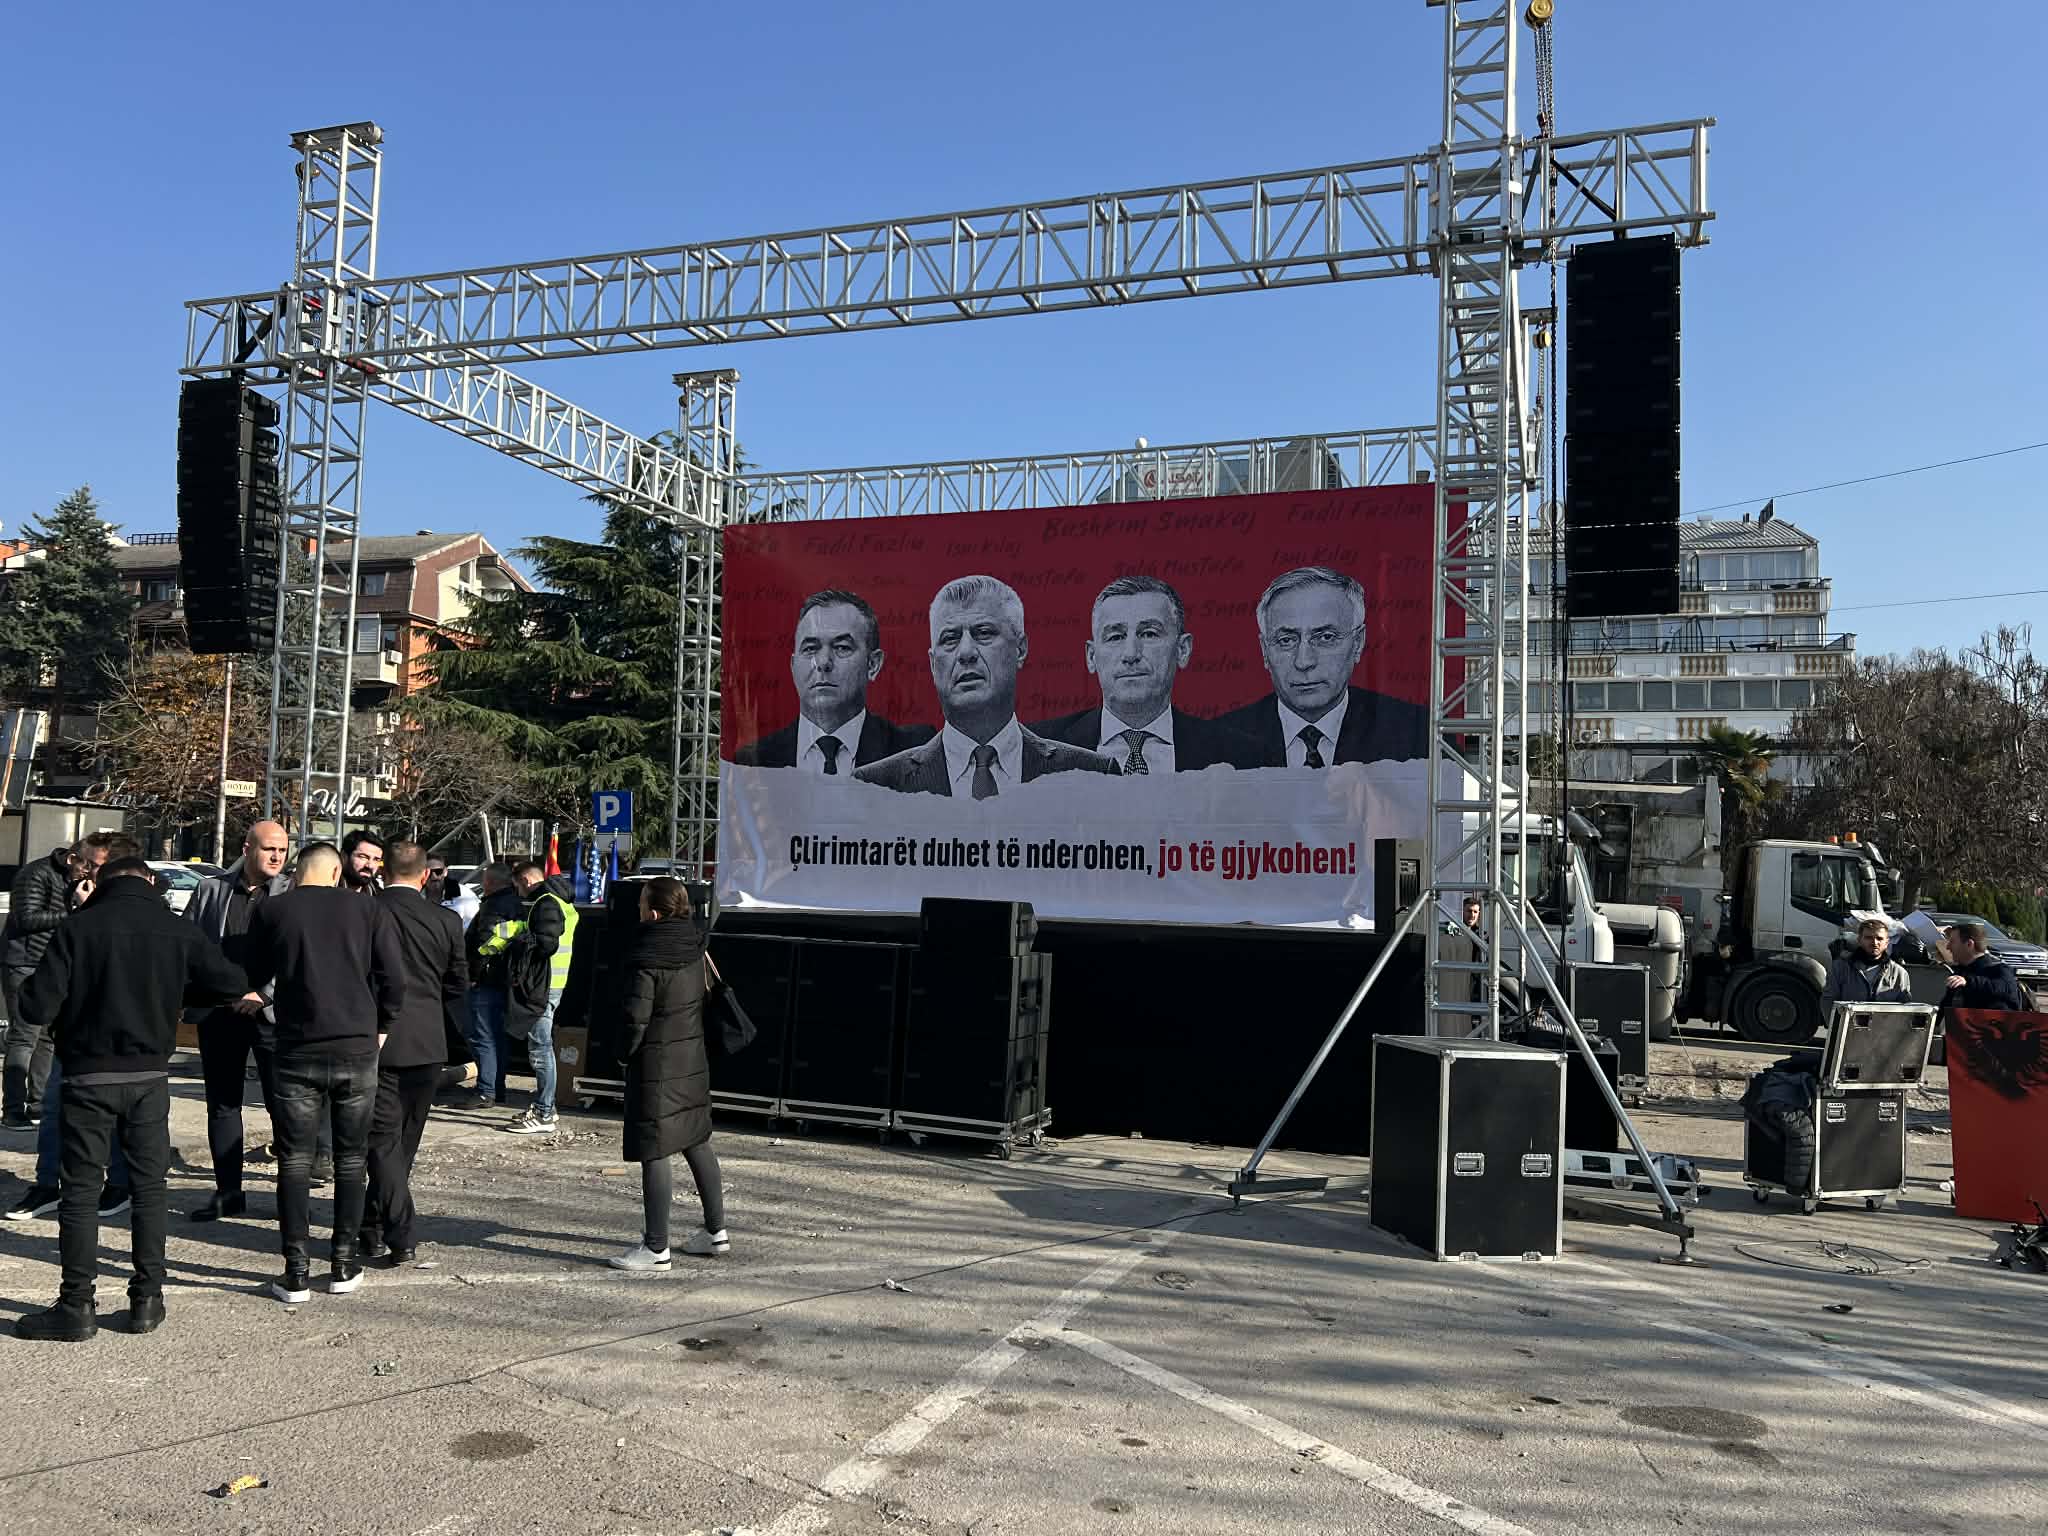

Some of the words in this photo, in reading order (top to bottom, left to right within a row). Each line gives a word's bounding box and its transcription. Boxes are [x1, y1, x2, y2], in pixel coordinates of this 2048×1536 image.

[599, 795, 620, 826] P
[789, 834, 917, 872] Çlirimtarët
[922, 837, 990, 868] duhet
[996, 837, 1021, 869] të
[1026, 838, 1153, 876] nderohen,
[1157, 838, 1183, 880] jo
[1188, 839, 1216, 873] të
[1221, 840, 1356, 881] gjykohen!
